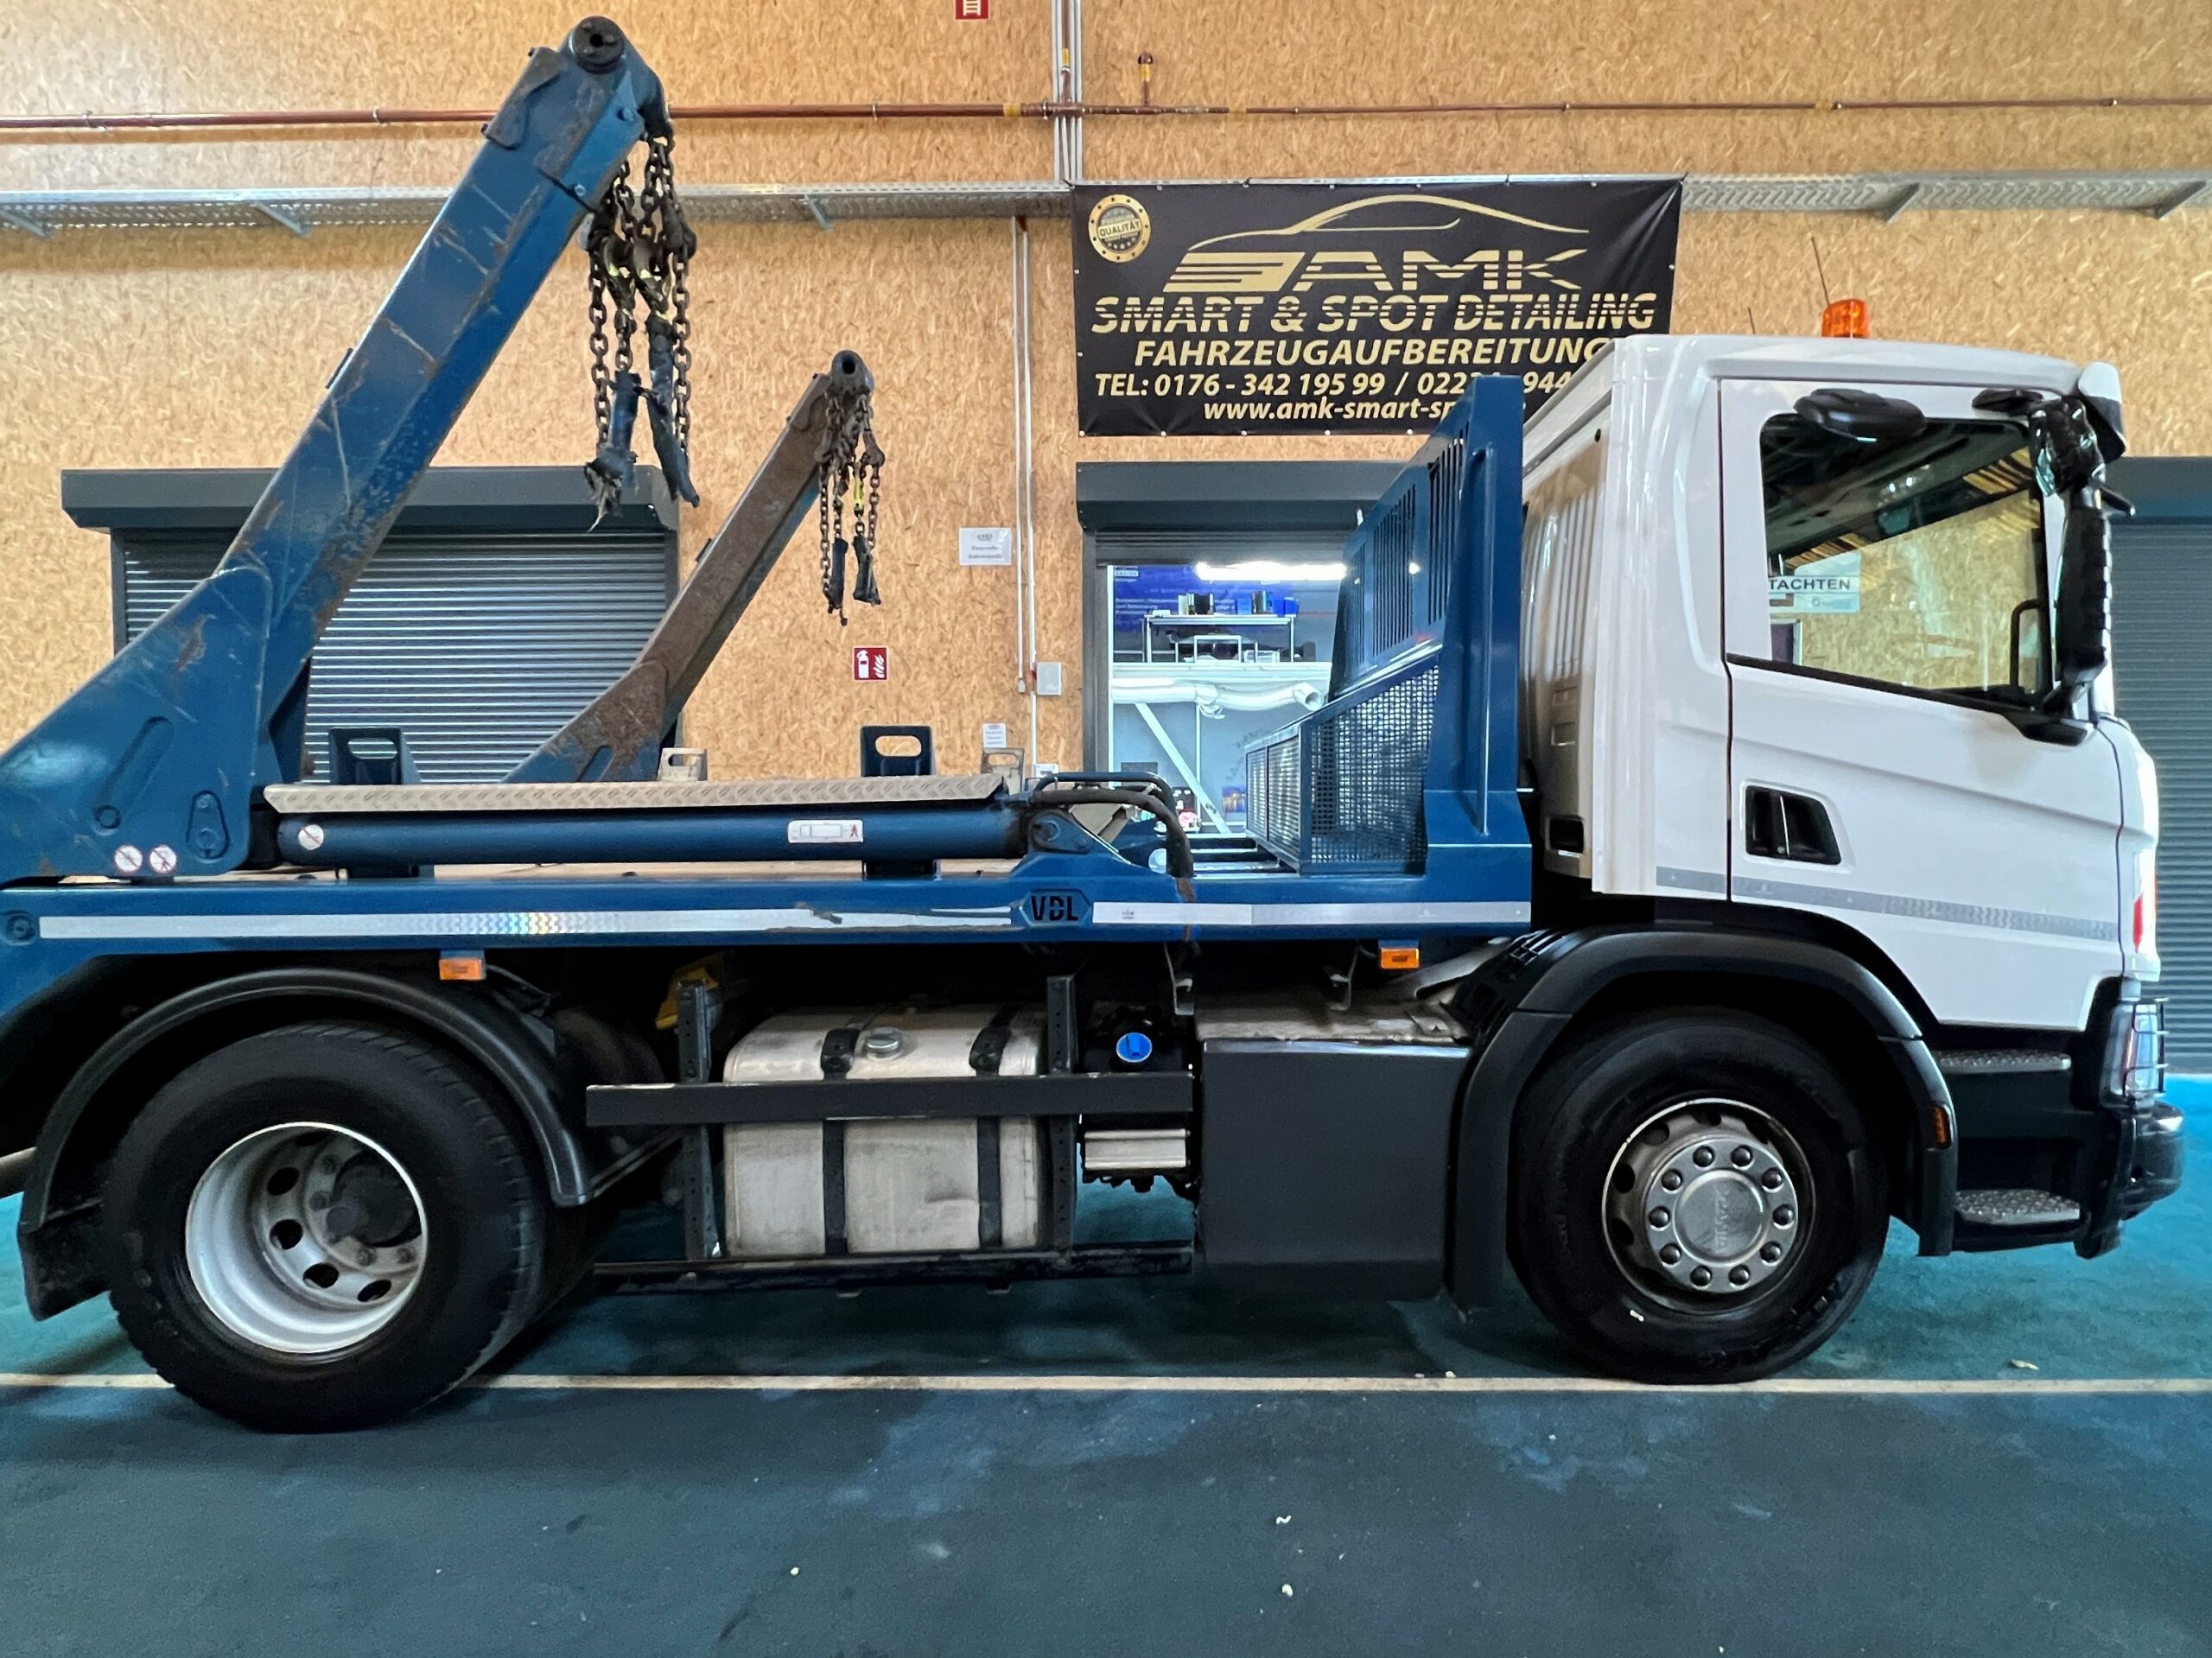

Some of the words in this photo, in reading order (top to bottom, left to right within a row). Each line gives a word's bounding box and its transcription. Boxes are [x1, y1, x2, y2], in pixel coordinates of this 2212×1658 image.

[1292, 249, 1588, 292] AMK
[1091, 295, 1264, 334] SMART
[1270, 295, 1307, 333] &
[1317, 295, 1449, 332] SPOT
[1453, 292, 1657, 331] DETAILING
[1095, 373, 1149, 397] TEL:
[1154, 373, 1220, 397] 0176
[1241, 373, 1291, 396] 342
[1300, 372, 1346, 396] 195
[1351, 372, 1386, 396] 99
[1415, 372, 1501, 395] 022
[1030, 895, 1079, 922] VDL
